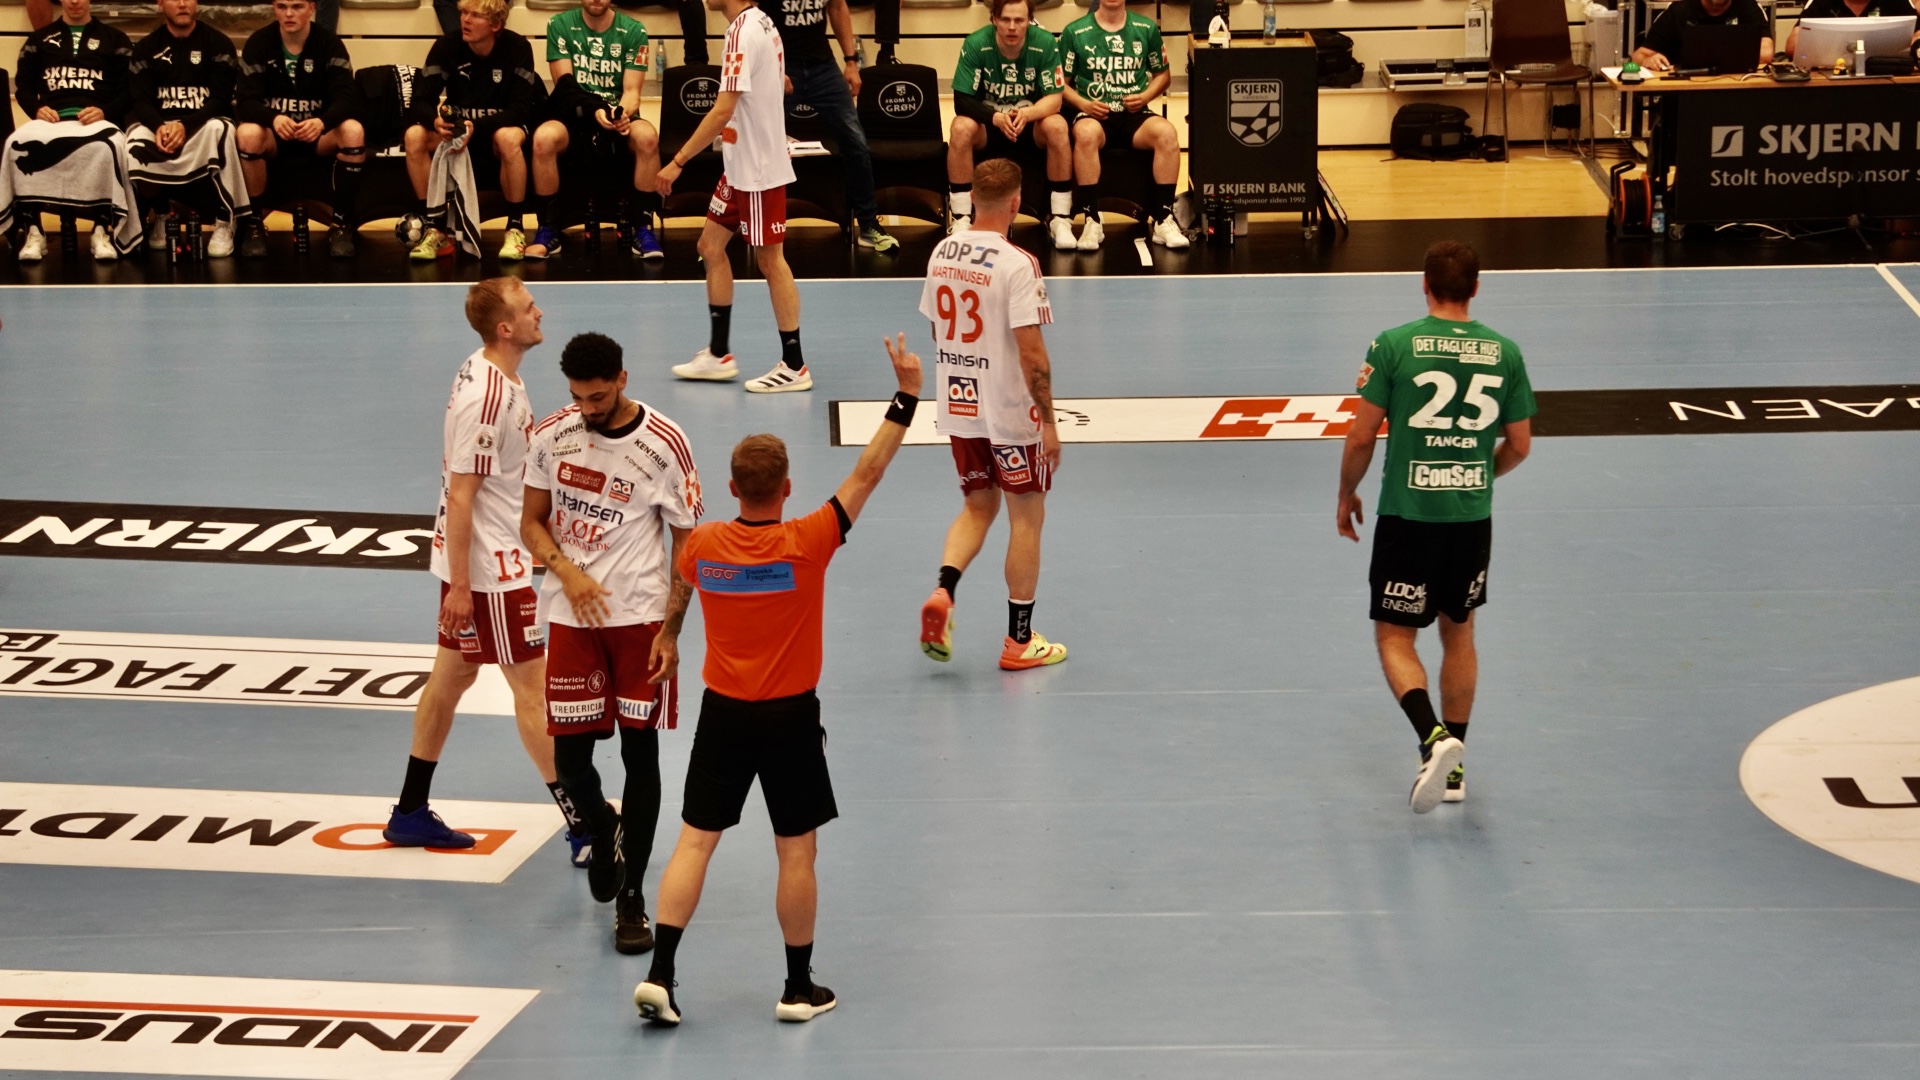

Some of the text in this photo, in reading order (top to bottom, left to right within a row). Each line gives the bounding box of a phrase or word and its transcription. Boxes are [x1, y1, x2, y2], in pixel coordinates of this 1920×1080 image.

[1086, 56, 1144, 72] SKJERN
[47, 79, 96, 92] BANK
[577, 70, 616, 88] BANK
[1092, 71, 1136, 84] BANK
[983, 80, 1035, 98] SKJERN
[1233, 84, 1277, 95] SKJERN
[885, 103, 916, 112] GRØN
[1757, 121, 1901, 160] SKJERN
[1710, 169, 1758, 187] Stolt
[1218, 182, 1306, 196] SKJERN BANK
[1290, 196, 1306, 204] 1992
[936, 240, 973, 262] ADP
[932, 265, 992, 287] MARTINUSEN
[936, 285, 983, 344] 93
[1416, 338, 1499, 356] DET FAGLIGE HUS
[1408, 370, 1504, 431] 25
[1669, 397, 1920, 421] AEN
[1424, 434, 1478, 448] TANGEN
[634, 438, 669, 471] KENTAUR
[1414, 464, 1484, 487] ConSet
[0, 515, 434, 556] SKJERN
[495, 548, 525, 582] 13
[0, 656, 433, 700] DET FAGL
[550, 676, 585, 684] Fredericia
[554, 702, 603, 714] FREDERICIA
[554, 713, 603, 723] SHIPPING
